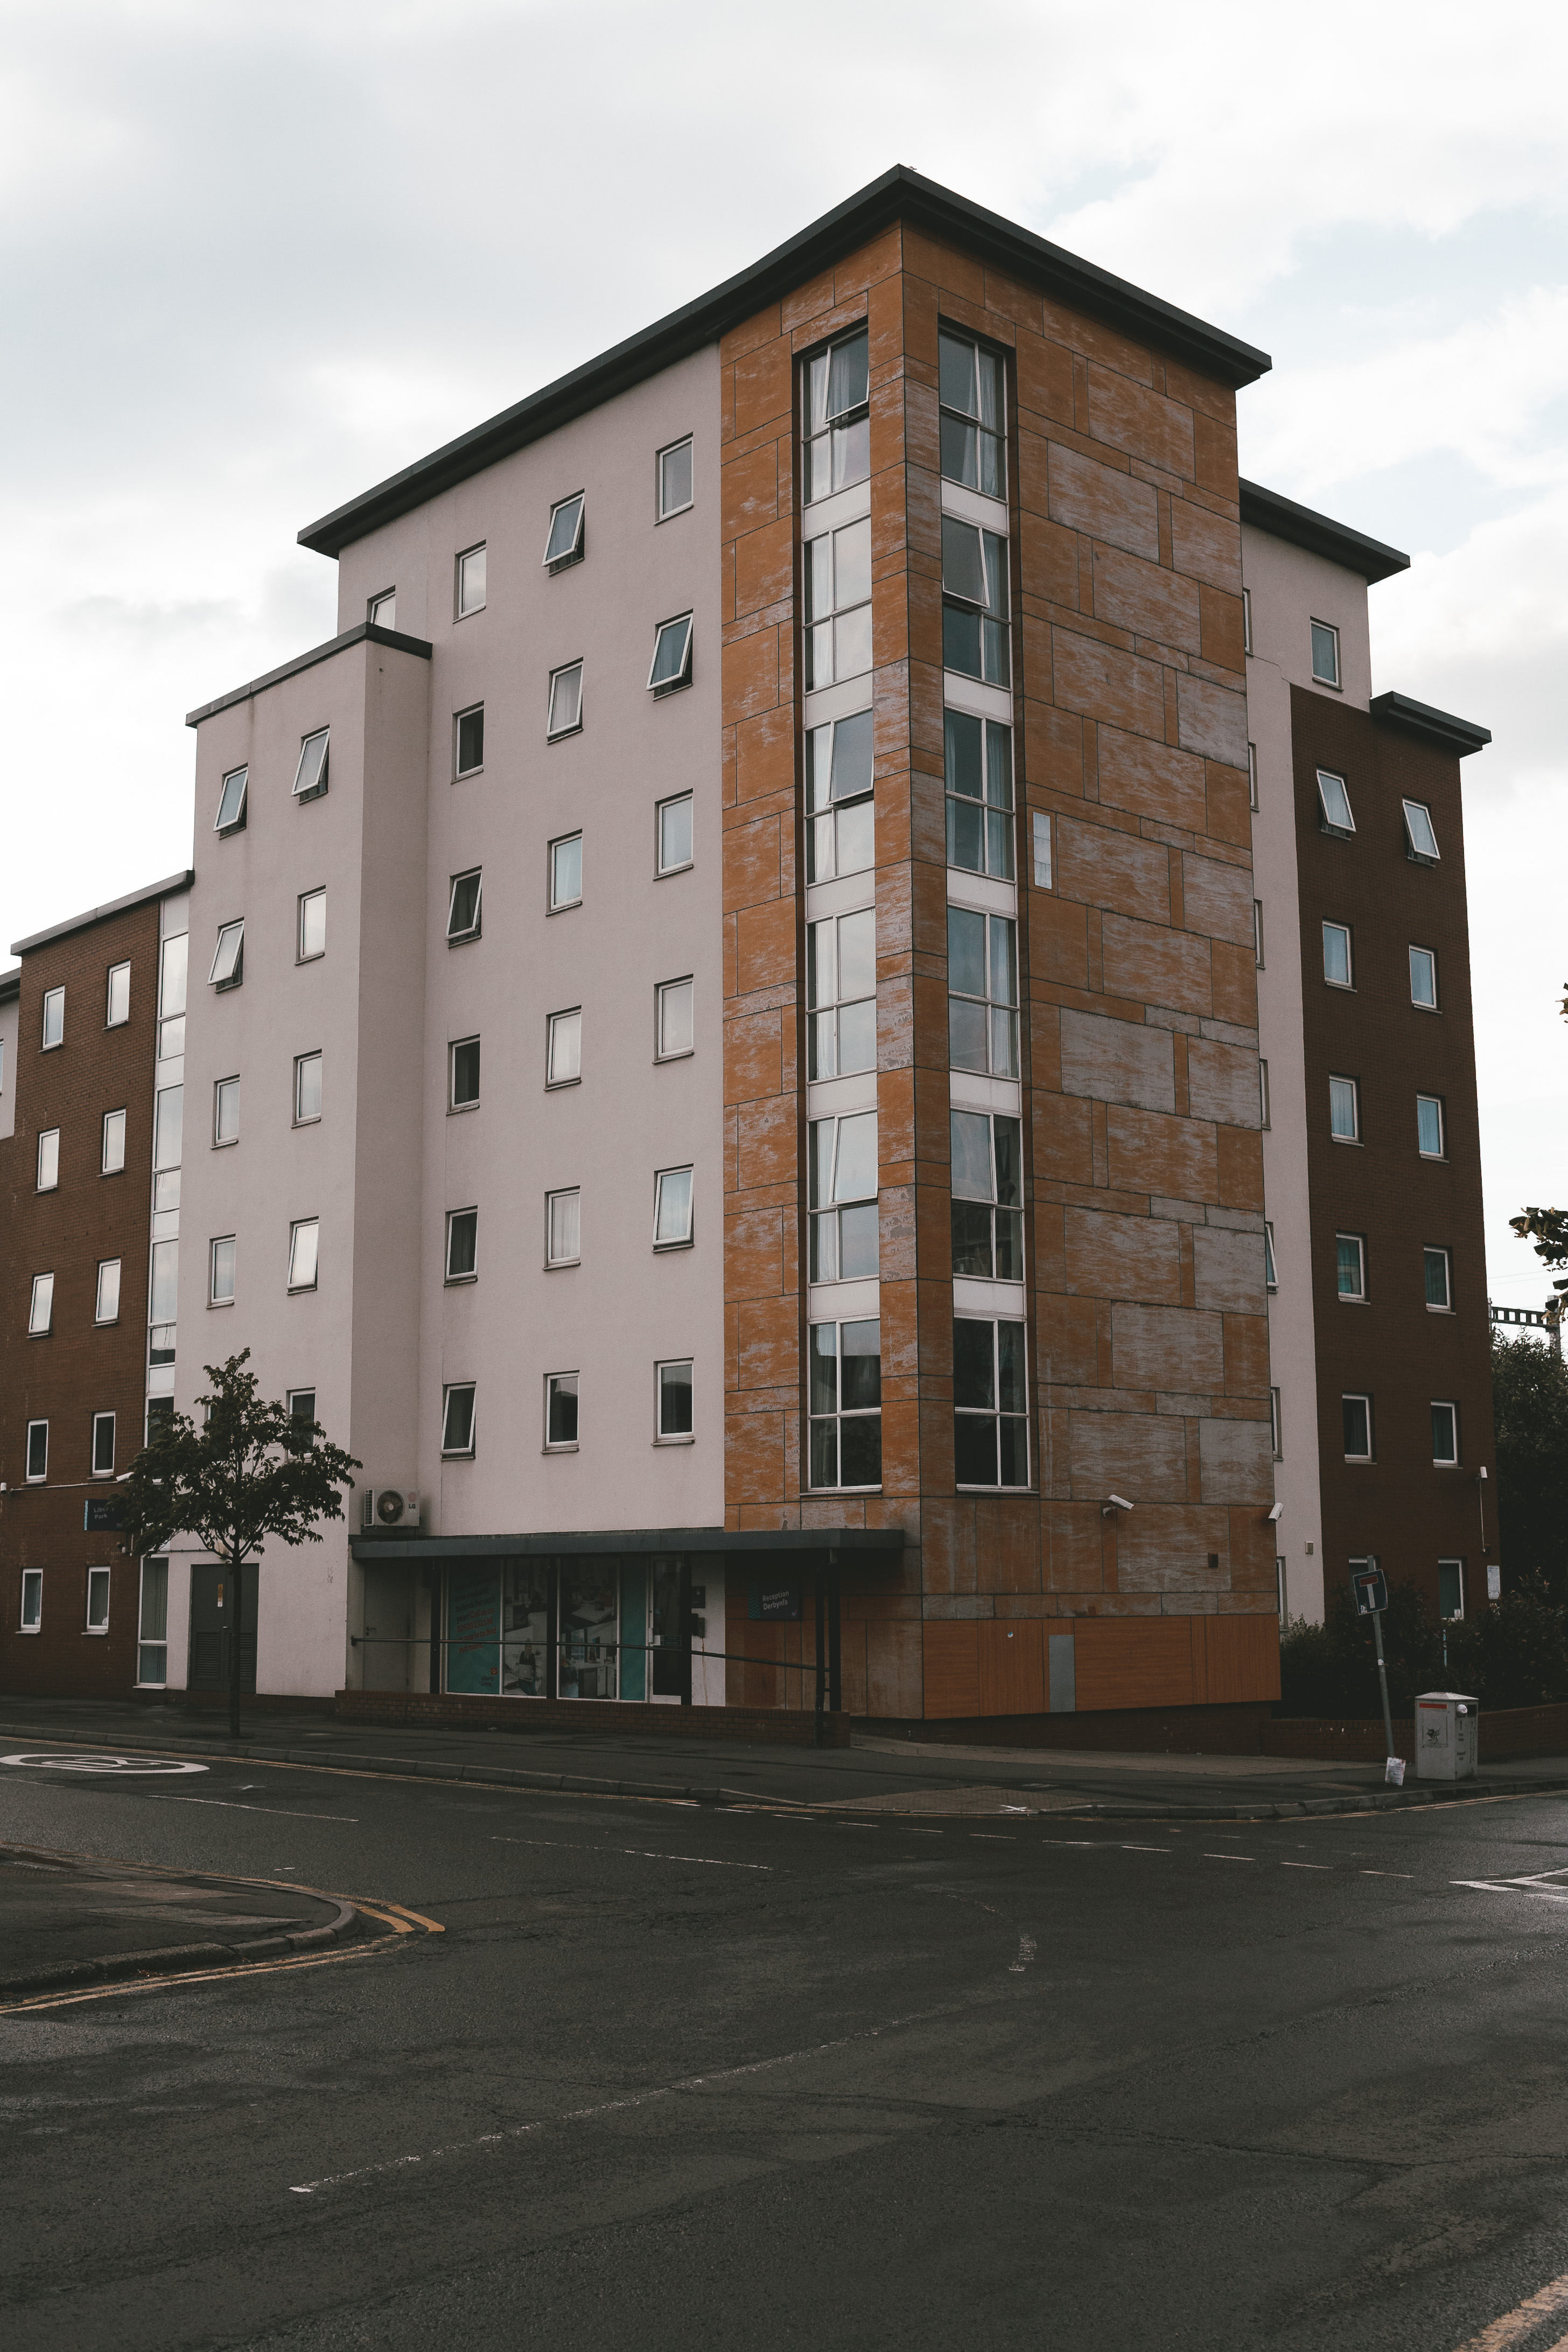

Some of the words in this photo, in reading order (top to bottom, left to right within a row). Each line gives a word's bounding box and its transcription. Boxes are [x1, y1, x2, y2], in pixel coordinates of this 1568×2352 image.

[762, 1591, 789, 1601] Reception
[461, 1600, 474, 1611] book
[763, 1599, 788, 1610] Derbynfa
[470, 1609, 480, 1619] Call
[457, 1622, 473, 1633] 02920
[486, 1626, 496, 1636] find
[458, 1645, 468, 1653] out
